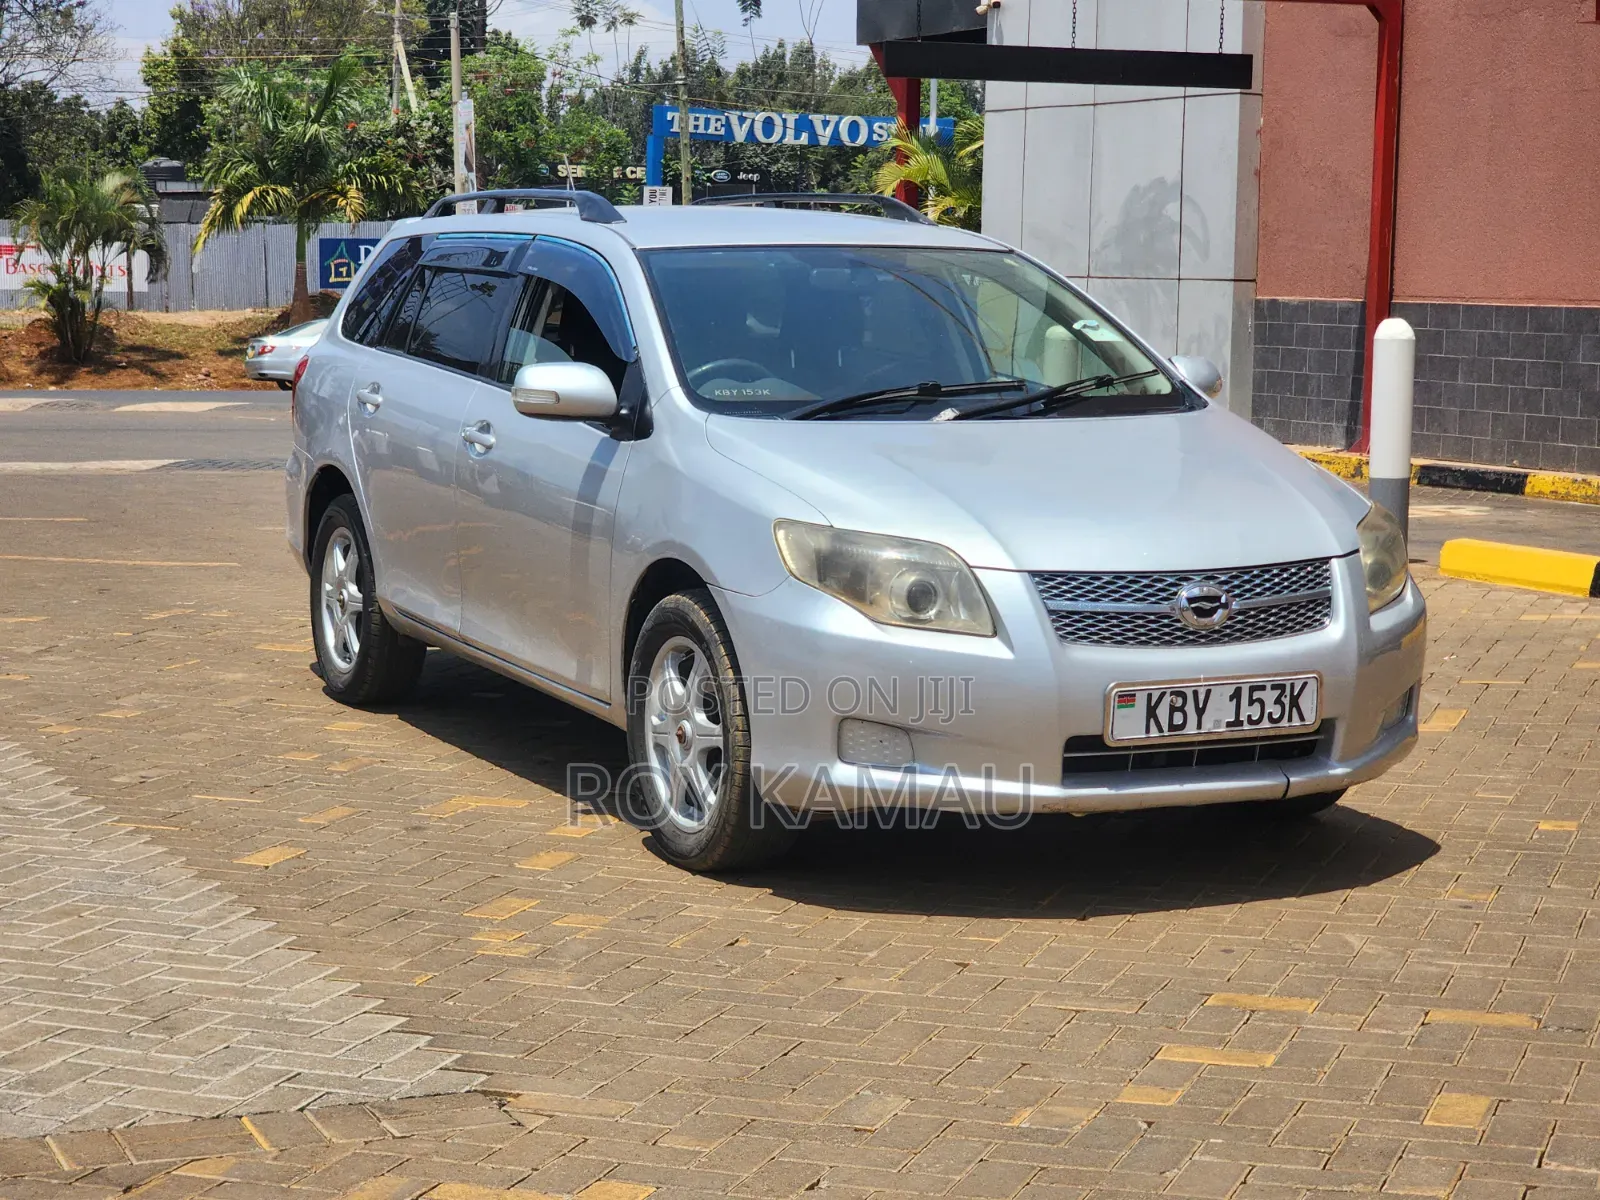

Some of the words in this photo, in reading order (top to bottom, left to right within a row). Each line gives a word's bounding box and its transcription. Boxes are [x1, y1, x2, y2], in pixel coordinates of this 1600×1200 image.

[667, 111, 725, 136] THE
[725, 111, 868, 147] VOLVO
[1144, 688, 1212, 735] KBY
[1225, 681, 1309, 729] 153K
